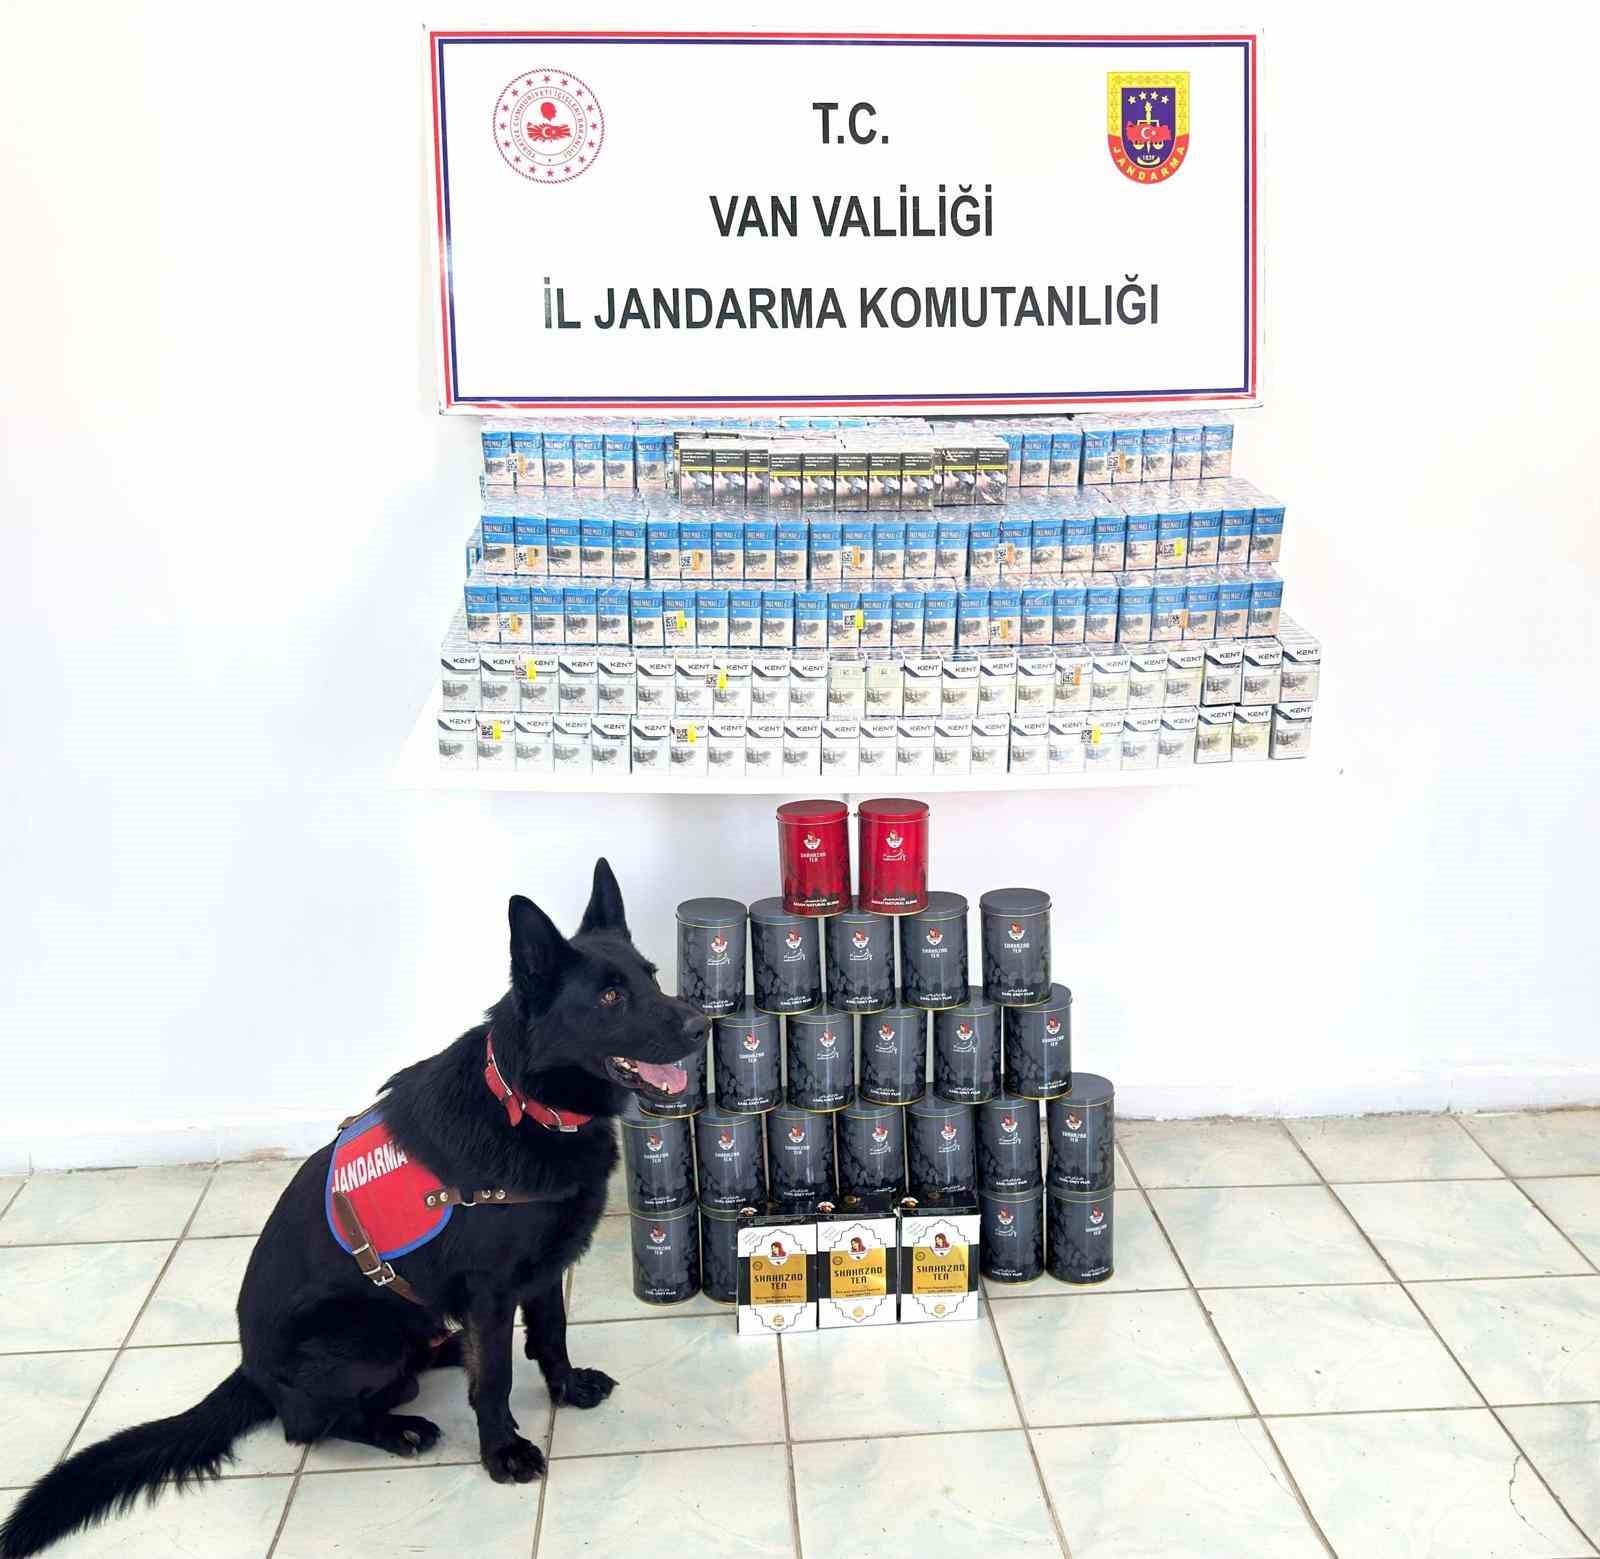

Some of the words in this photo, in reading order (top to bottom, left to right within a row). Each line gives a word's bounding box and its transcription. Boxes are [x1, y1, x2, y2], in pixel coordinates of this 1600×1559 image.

[813, 102, 889, 144] T.C.
[1112, 146, 1185, 181] JANDARMA
[709, 195, 798, 238] VAN
[812, 184, 993, 237] VALİLİĞİ
[543, 276, 581, 330] İL
[594, 287, 847, 330] JANDARMA
[860, 273, 1158, 328] KOMUTANLIĞI
[331, 1141, 409, 1193] JANDARMA
[834, 1266, 883, 1277] SHAHRZAD
[916, 1264, 965, 1273] SHAHRZAD
[754, 1273, 803, 1283] SHAHRZAD
[850, 1276, 867, 1285] TEA
[933, 1272, 949, 1281] TEA
[770, 1282, 787, 1290] TEA
